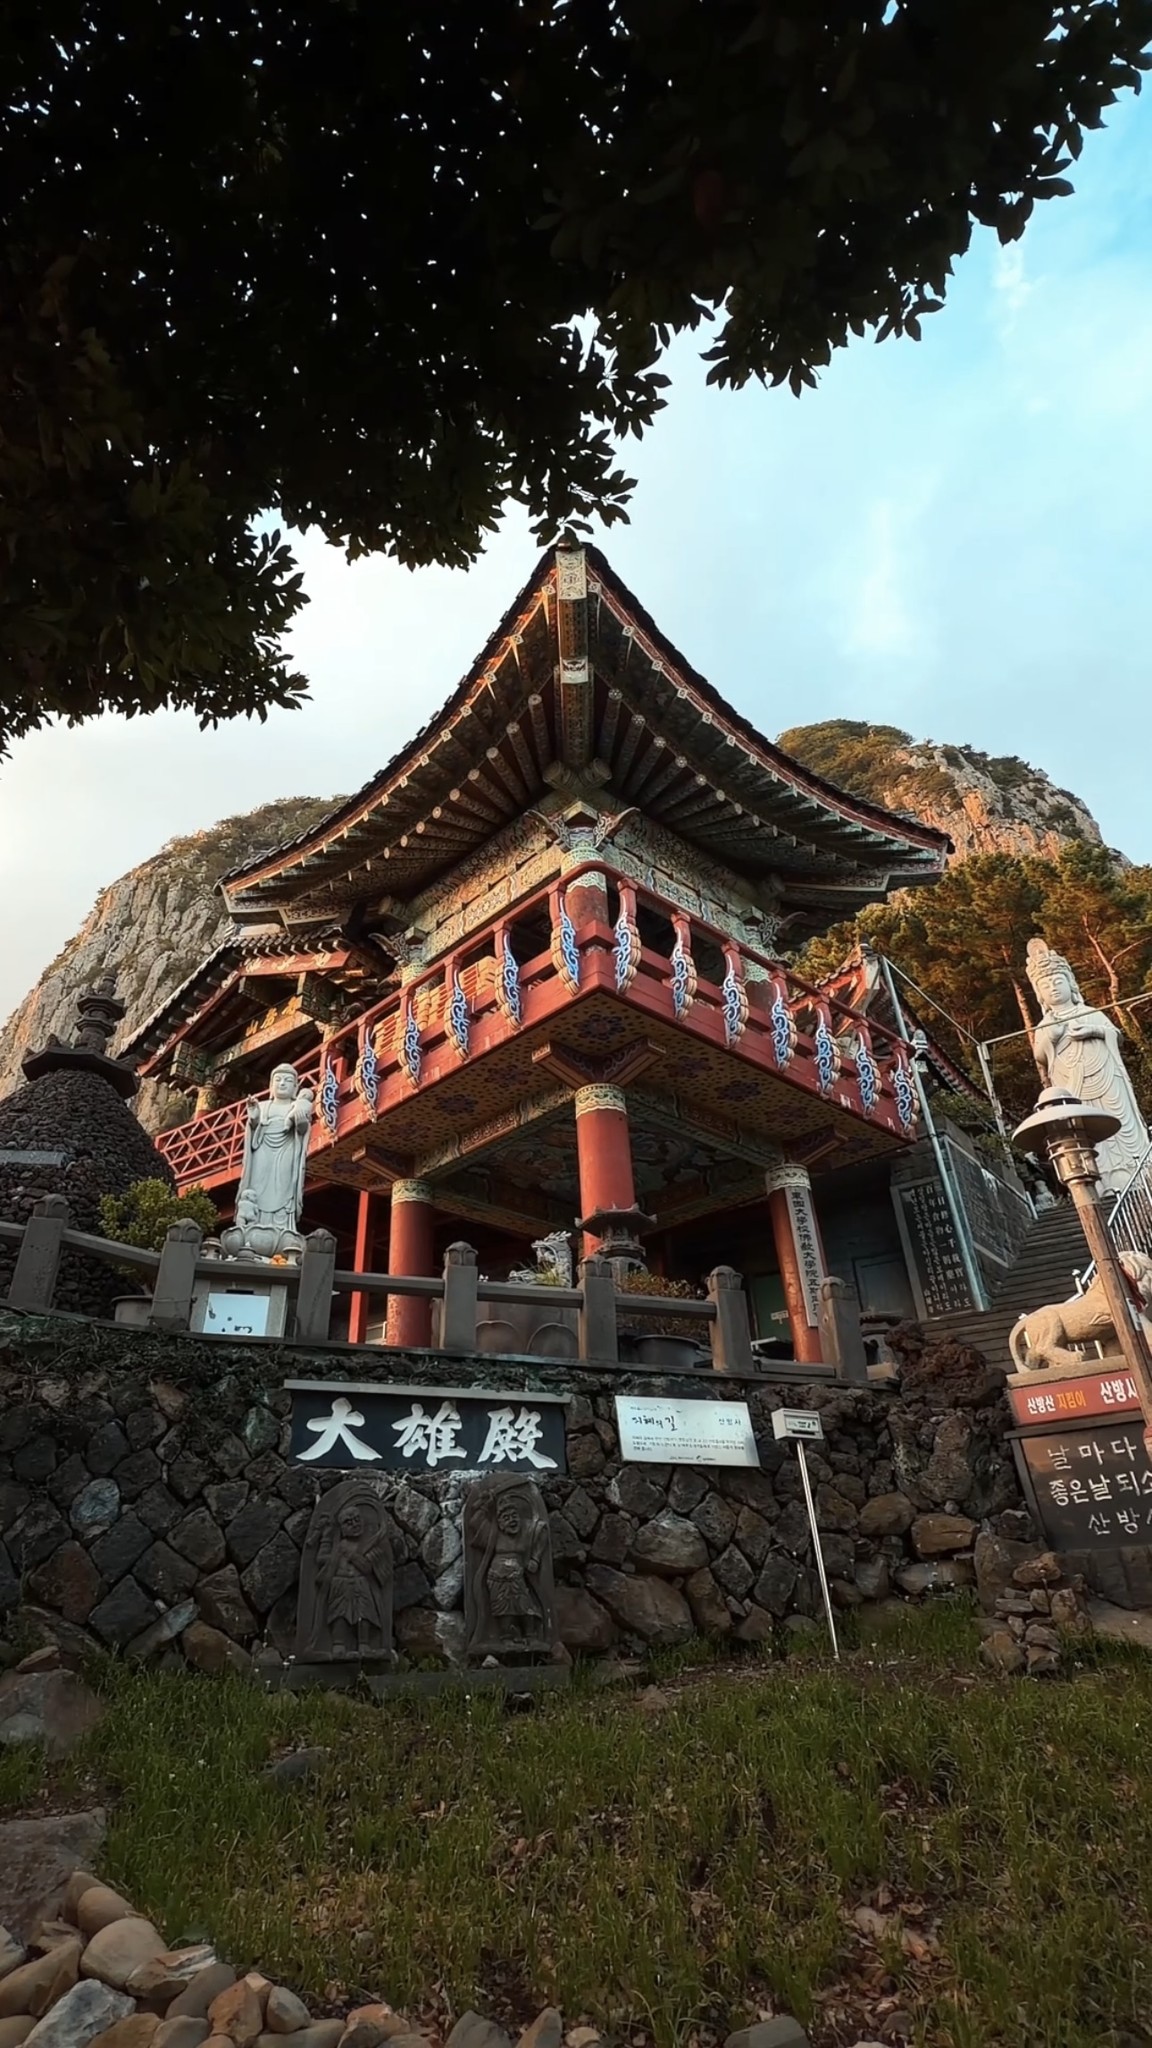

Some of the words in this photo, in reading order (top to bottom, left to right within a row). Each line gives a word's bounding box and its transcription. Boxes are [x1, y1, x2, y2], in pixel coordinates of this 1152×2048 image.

[1027, 1395, 1056, 1415] 산방산
[1056, 1390, 1087, 1410] 지킴이
[296, 1396, 558, 1469] 大雄殿
[664, 1415, 678, 1431] 길
[1088, 1506, 1152, 1536] 산방
